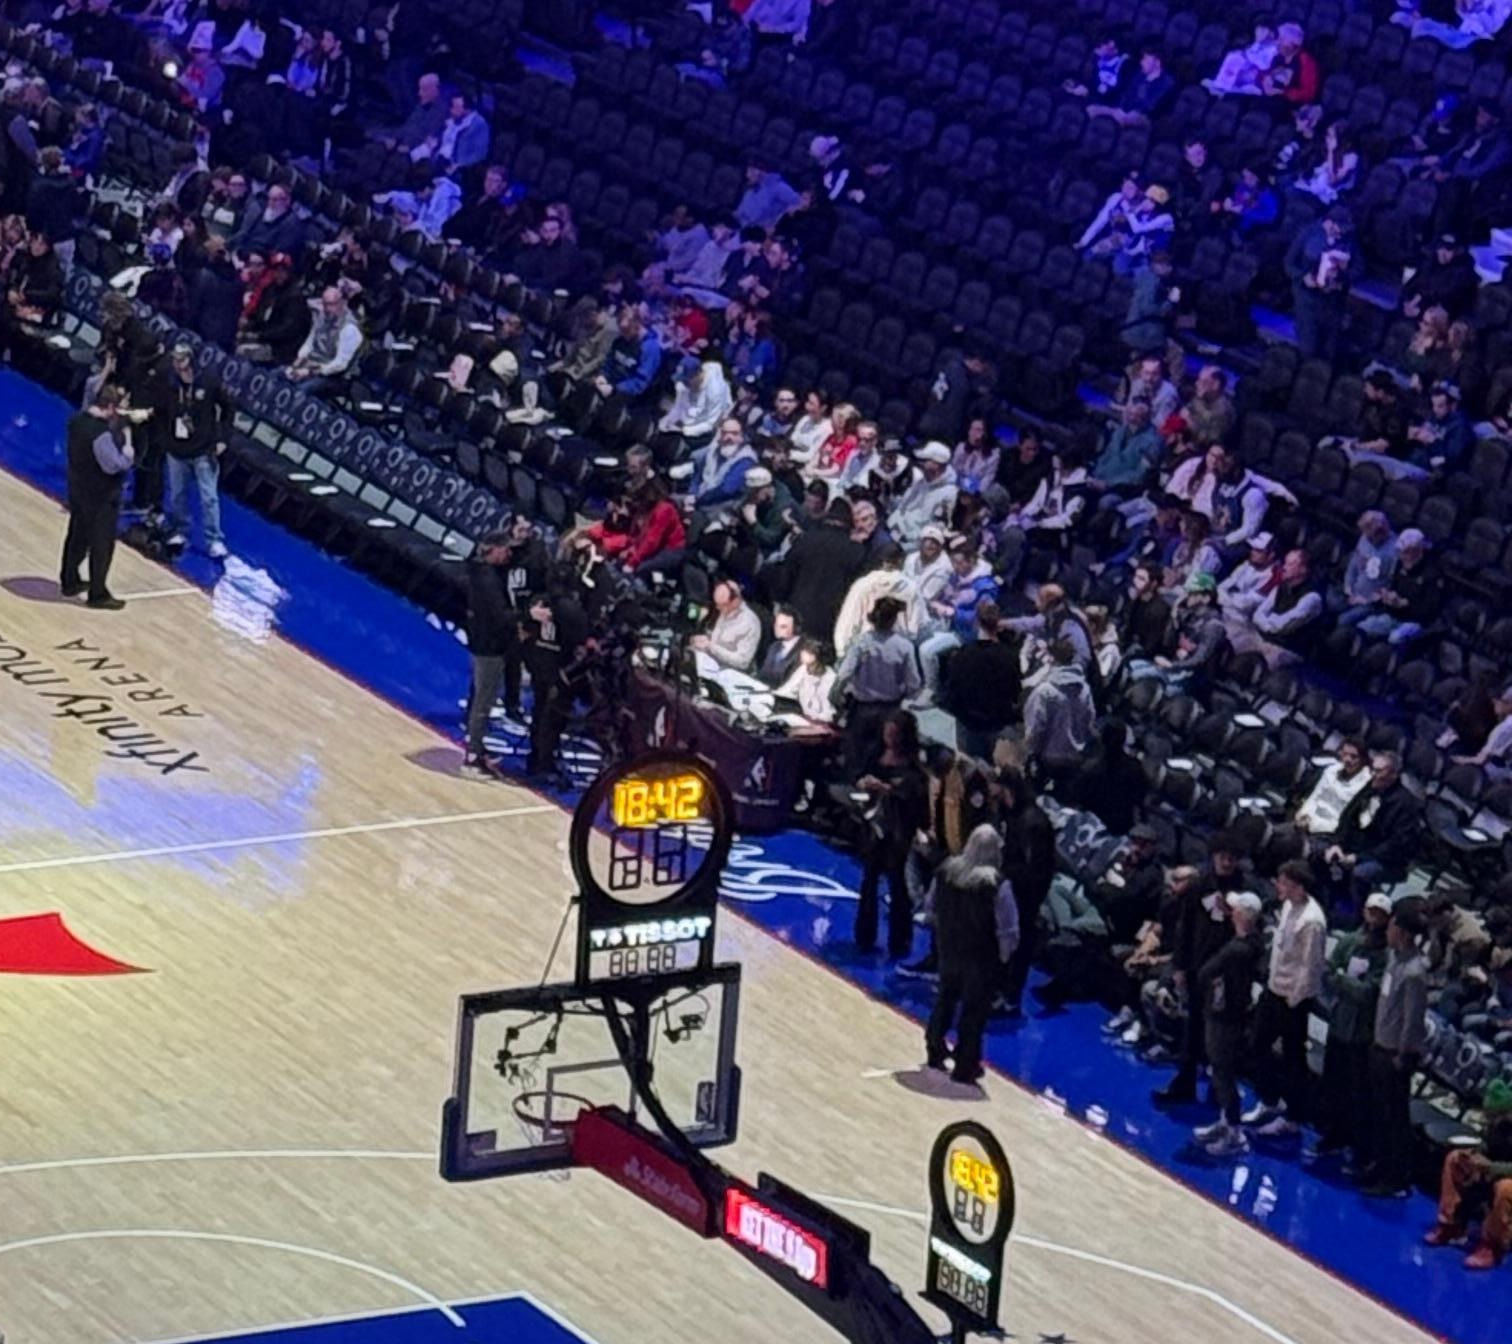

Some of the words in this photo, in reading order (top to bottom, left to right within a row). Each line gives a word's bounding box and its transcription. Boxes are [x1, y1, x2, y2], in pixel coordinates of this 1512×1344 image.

[57, 637, 205, 718] ARENA
[614, 774, 705, 828] 18:42
[624, 916, 712, 946] TISSOT
